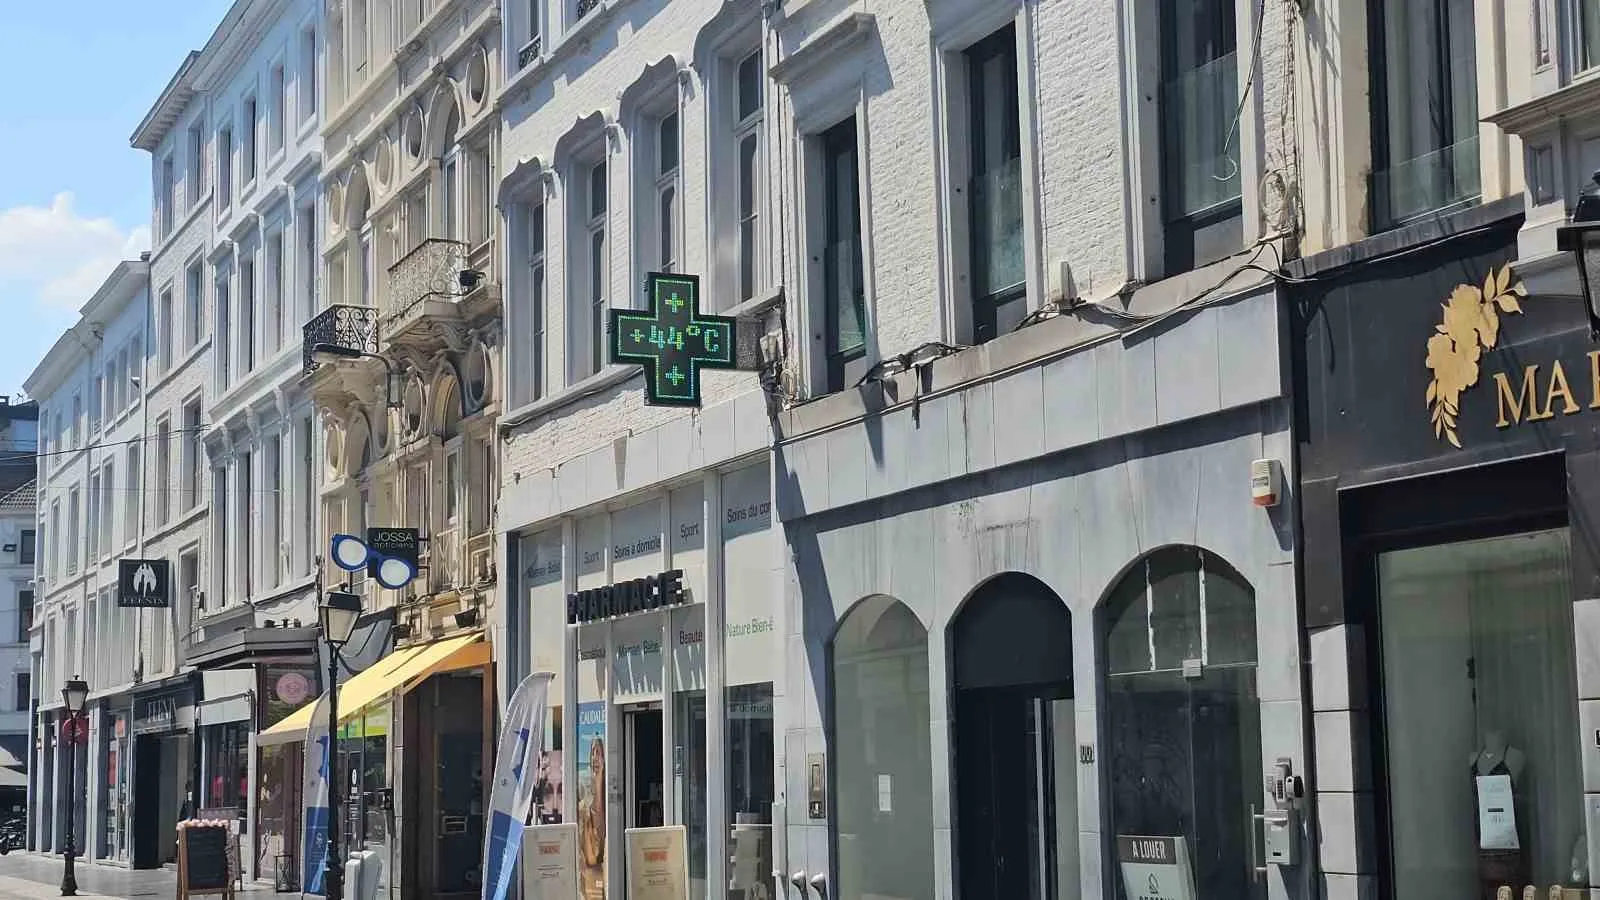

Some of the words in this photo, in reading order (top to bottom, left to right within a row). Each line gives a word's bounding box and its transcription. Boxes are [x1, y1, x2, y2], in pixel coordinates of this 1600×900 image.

[1493, 350, 1600, 428] MA
[727, 508, 746, 523] Soins
[749, 503, 758, 517] du
[374, 531, 414, 542] JOSSA
[680, 522, 699, 540] Sport
[614, 545, 630, 559] Soins
[567, 569, 683, 624] PHARMACIE
[727, 622, 750, 637] Nature
[1140, 840, 1167, 858] LOUER
